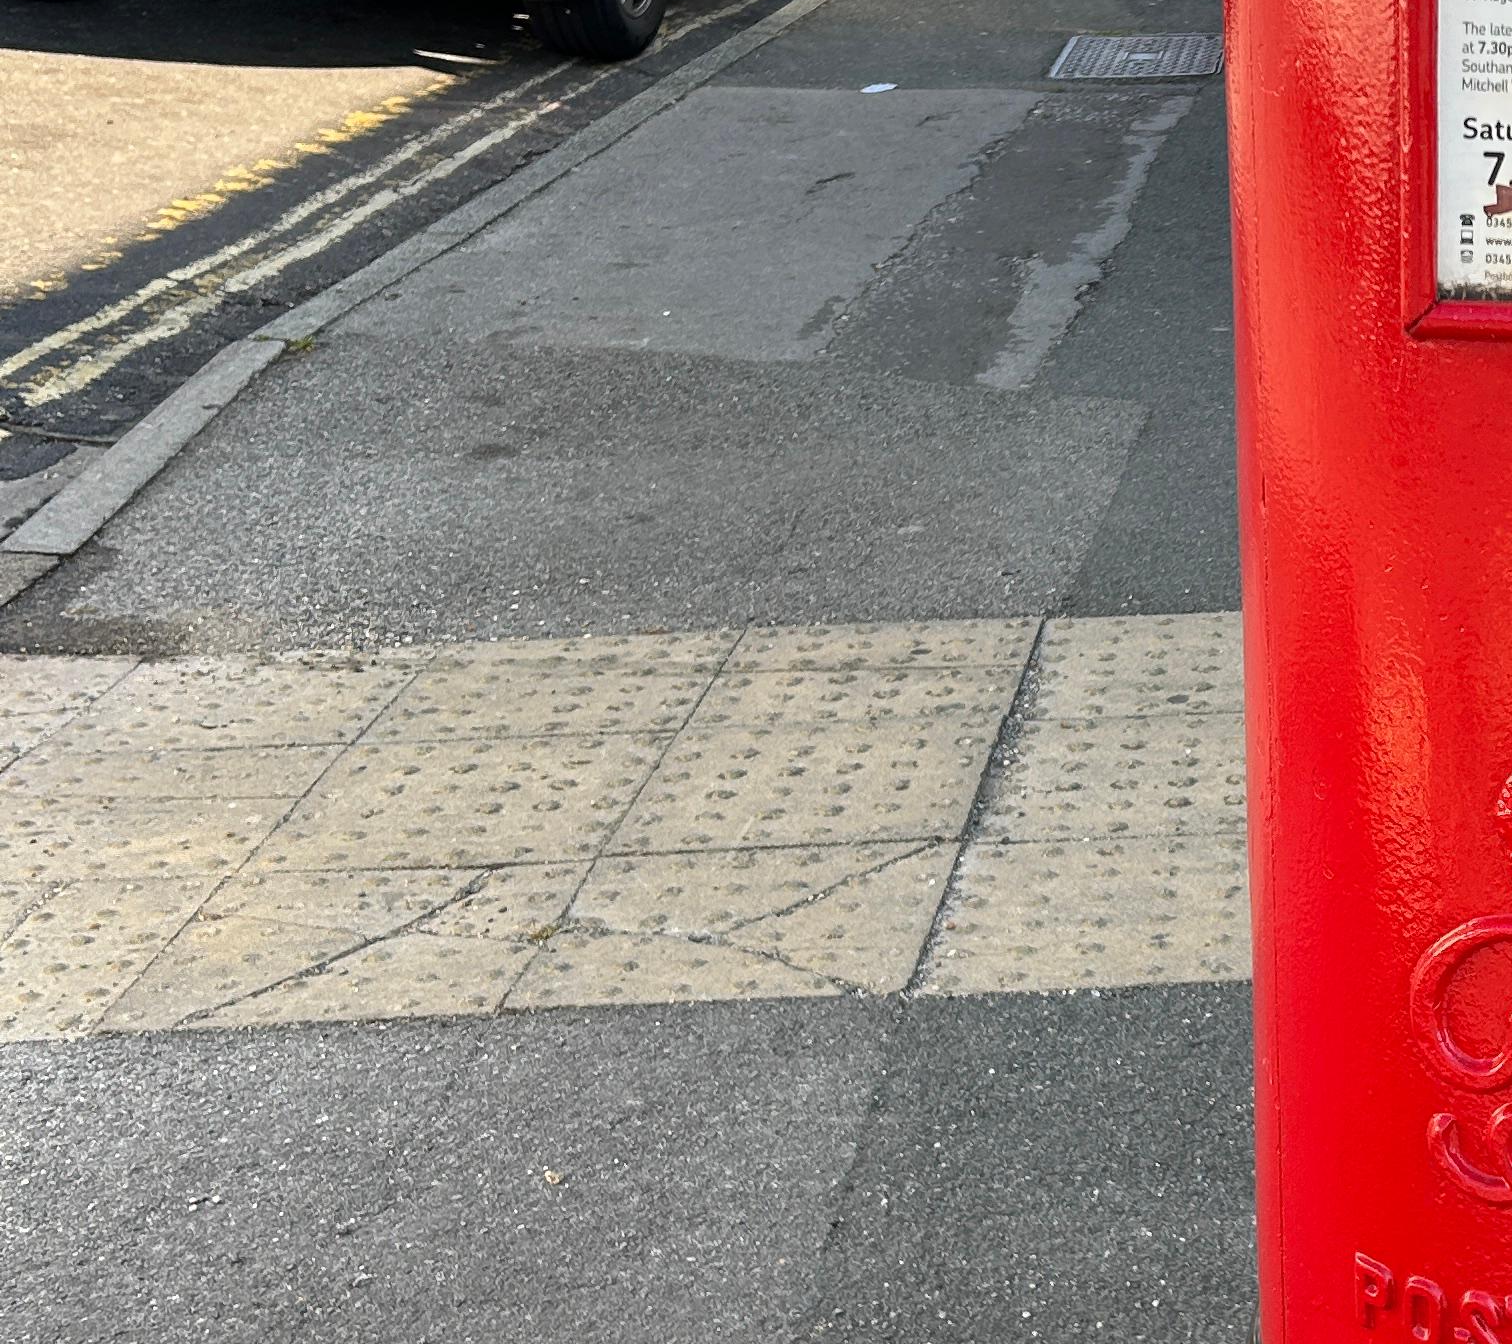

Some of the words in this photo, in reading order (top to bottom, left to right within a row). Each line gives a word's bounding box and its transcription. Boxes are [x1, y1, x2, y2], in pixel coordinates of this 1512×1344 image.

[1462, 21, 1486, 36] The
[1462, 42, 1475, 55] at
[1461, 78, 1508, 94] Mitchell
[1485, 253, 1512, 265] 0345
